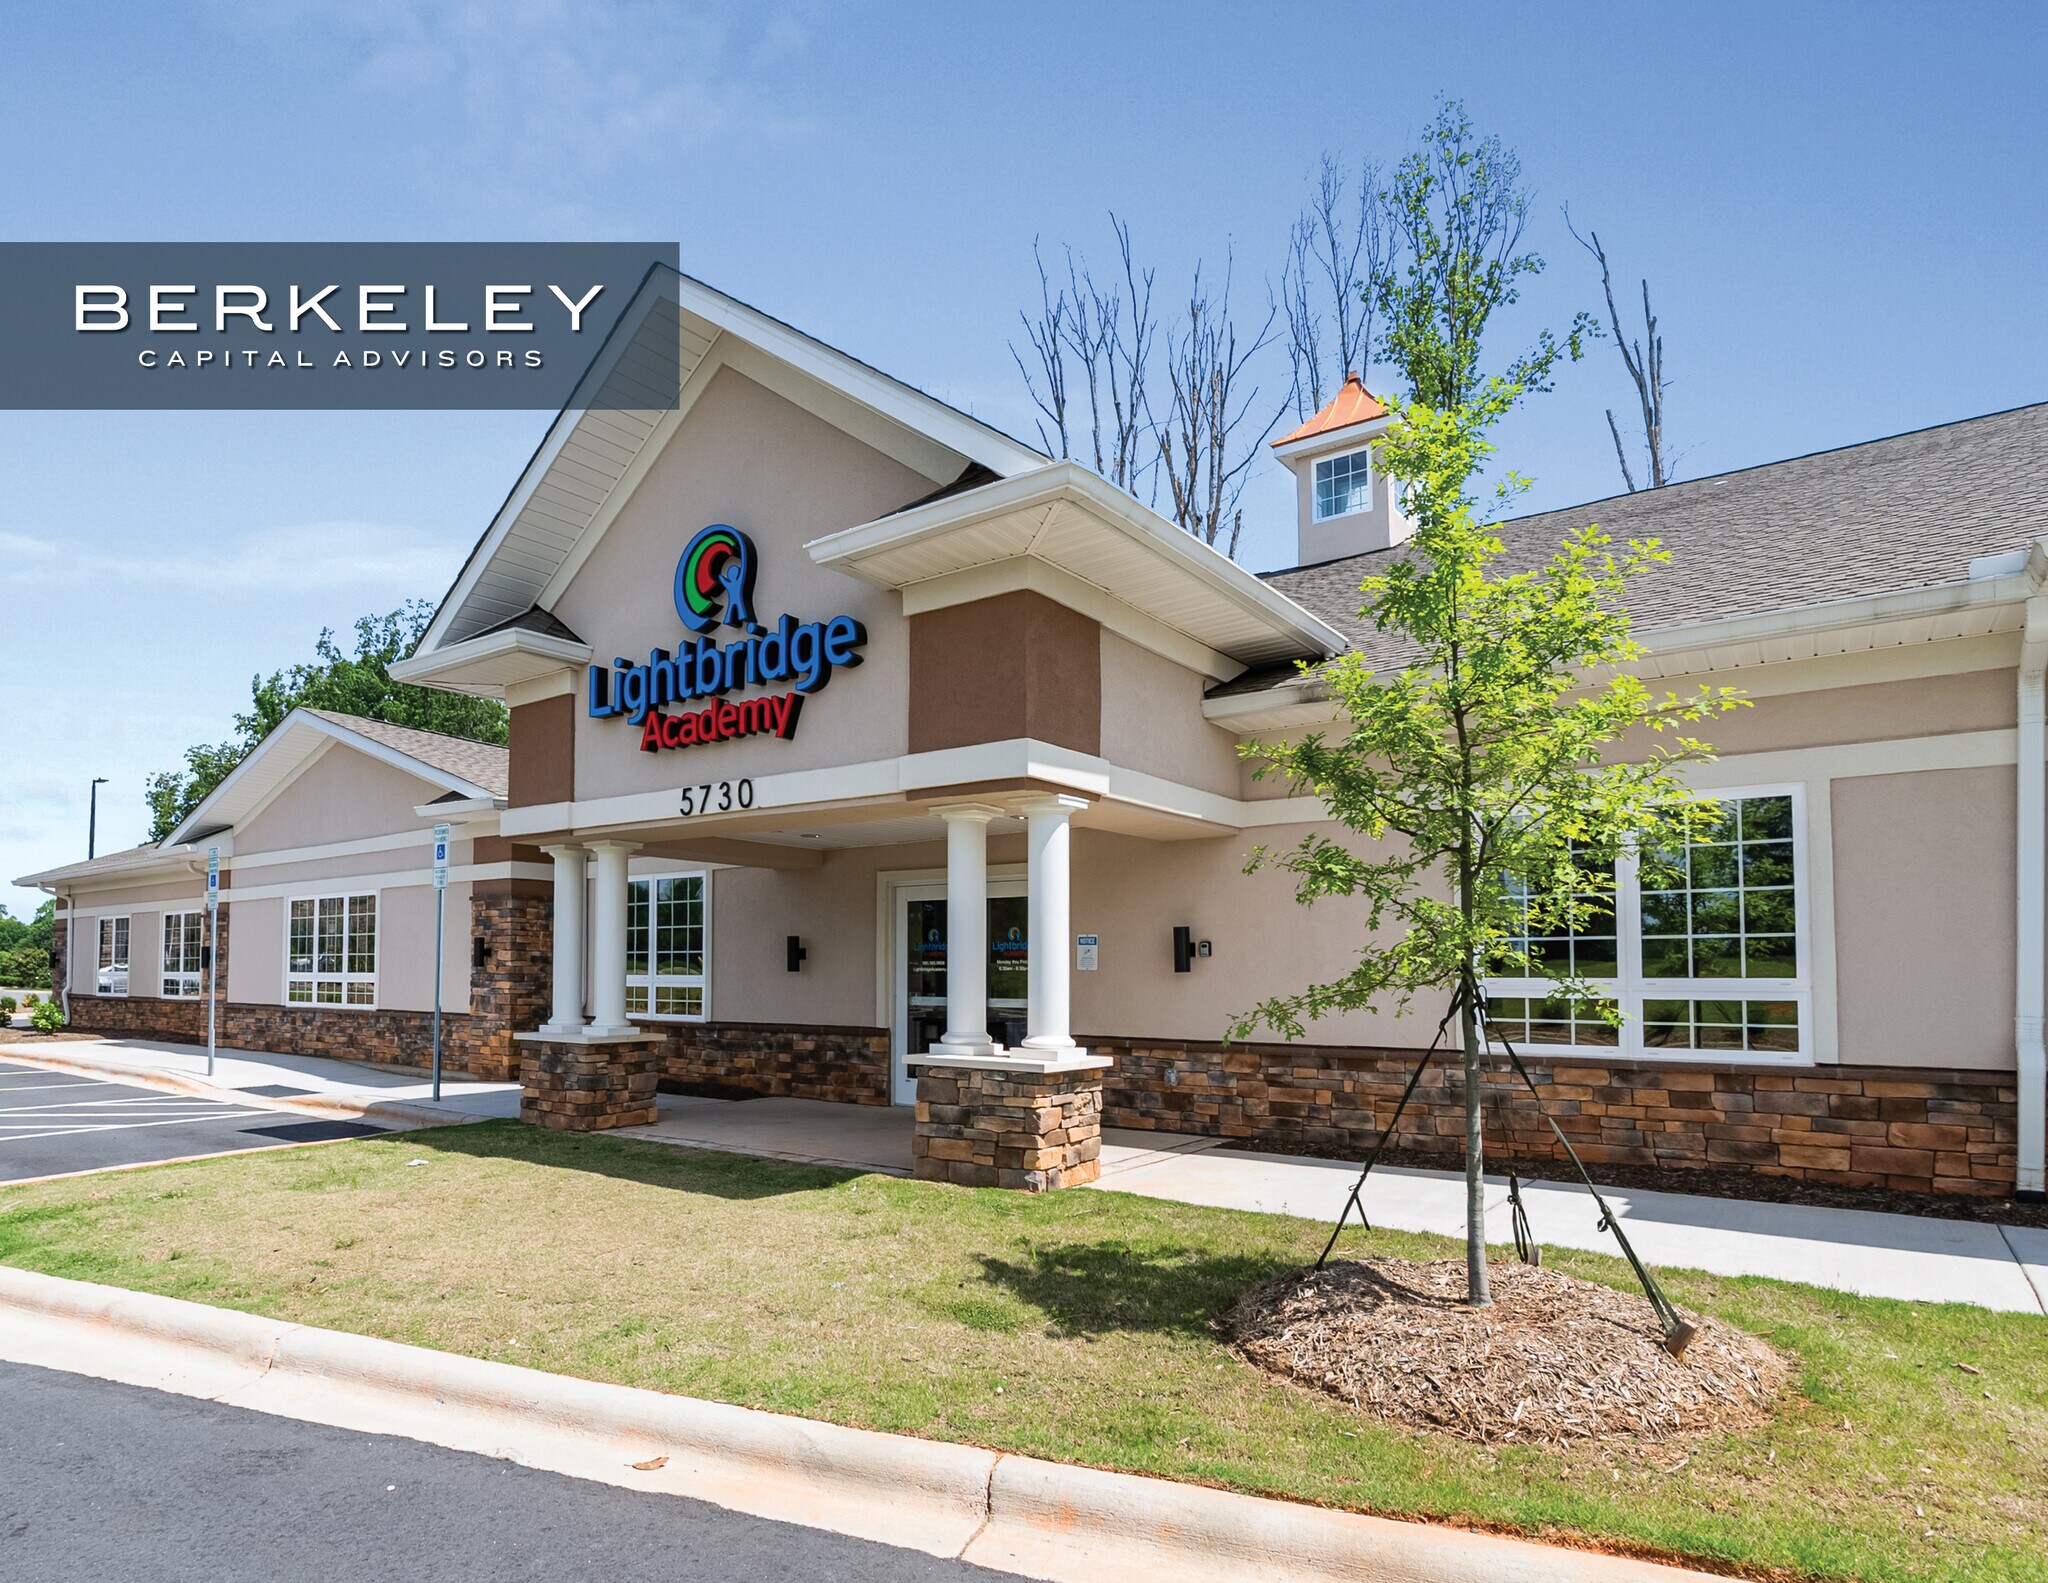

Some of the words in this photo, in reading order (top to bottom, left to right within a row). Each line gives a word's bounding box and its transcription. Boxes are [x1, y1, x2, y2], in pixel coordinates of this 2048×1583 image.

[589, 613, 867, 726] Lightbridge
[640, 692, 805, 752] Academy
[680, 778, 754, 815] 5730
[992, 941, 1028, 952] Lightbrid
